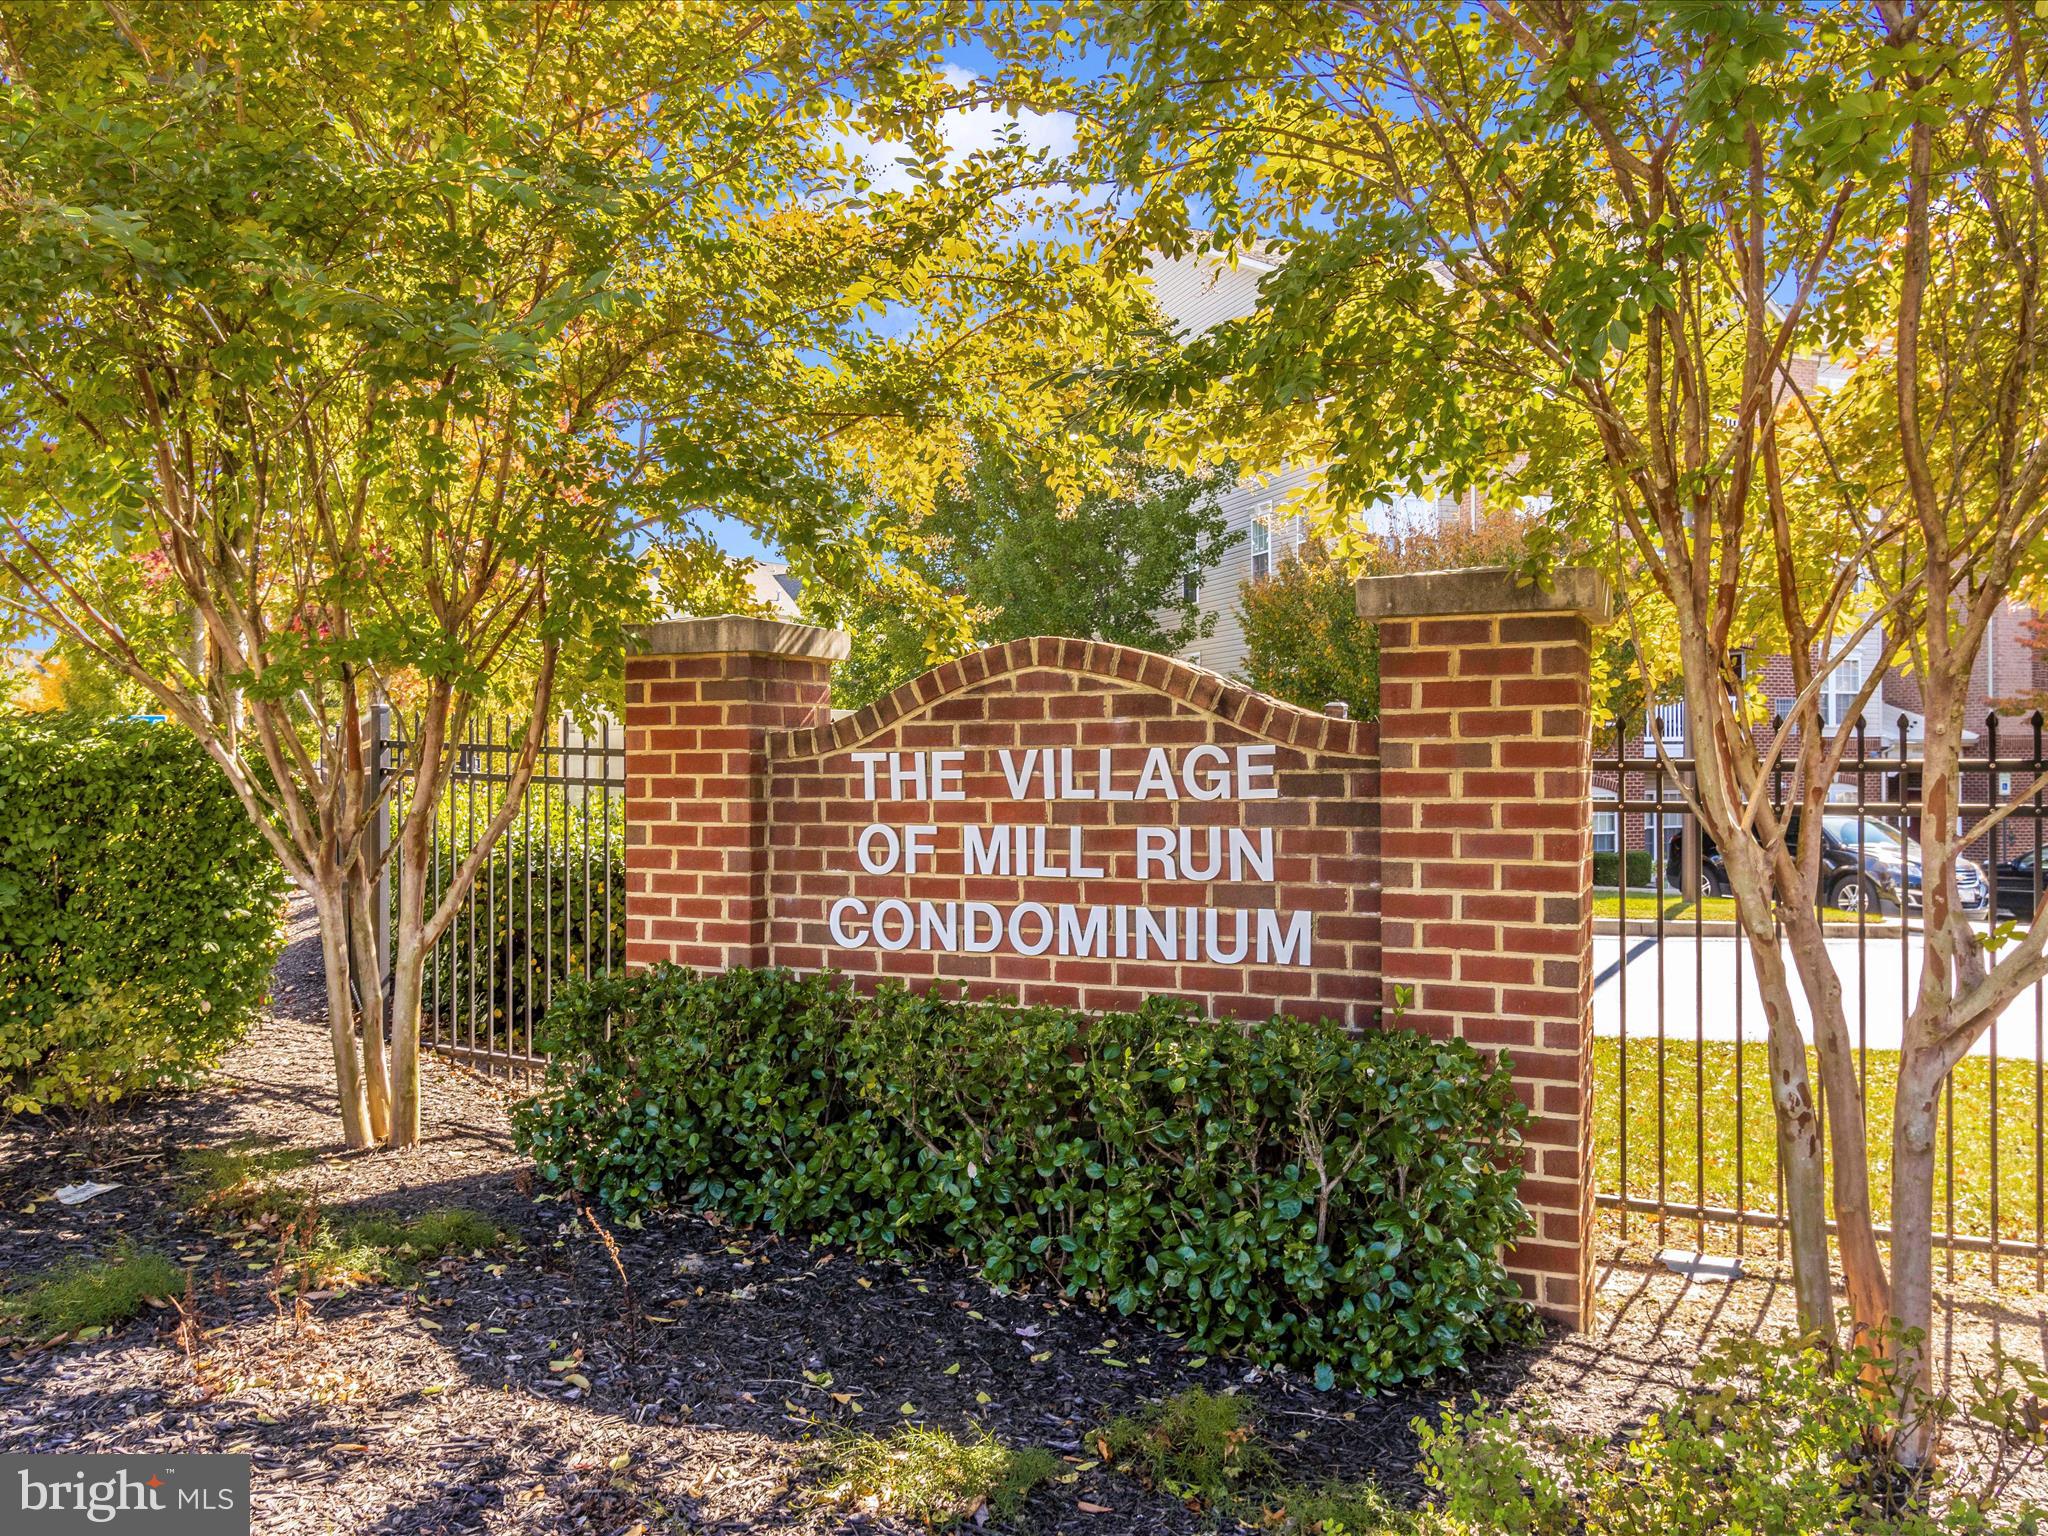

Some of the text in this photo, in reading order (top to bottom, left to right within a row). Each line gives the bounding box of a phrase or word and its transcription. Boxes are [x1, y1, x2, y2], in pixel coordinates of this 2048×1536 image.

[850, 744, 1279, 801] THE VILLAGE
[857, 823, 1275, 882] OF MILL RUN
[828, 897, 1312, 966] CONDOMINIUM
